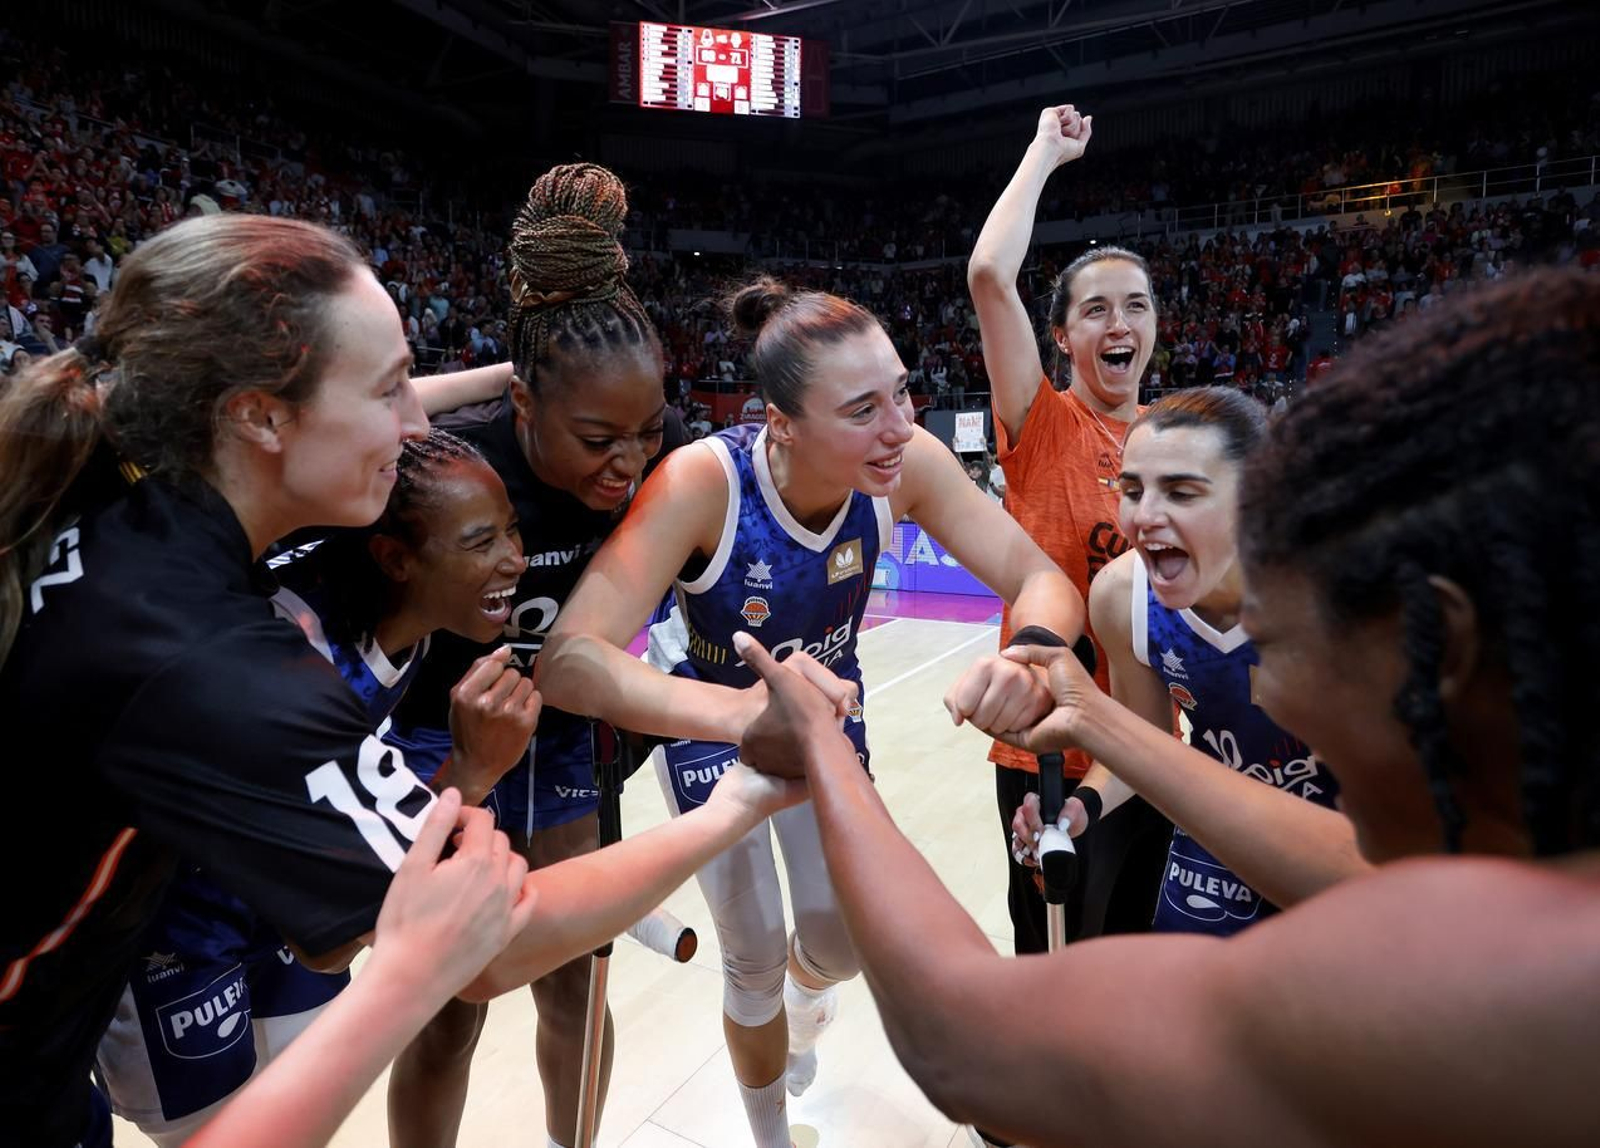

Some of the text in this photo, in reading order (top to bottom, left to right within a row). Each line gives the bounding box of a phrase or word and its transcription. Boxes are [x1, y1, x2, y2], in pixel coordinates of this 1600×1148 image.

[617, 41, 632, 99] AMBAR
[1088, 522, 1130, 559] CU
[744, 578, 773, 590] luanvi
[304, 733, 439, 874] 18
[1168, 861, 1252, 902] PULEVA
[147, 964, 185, 983] luanvi
